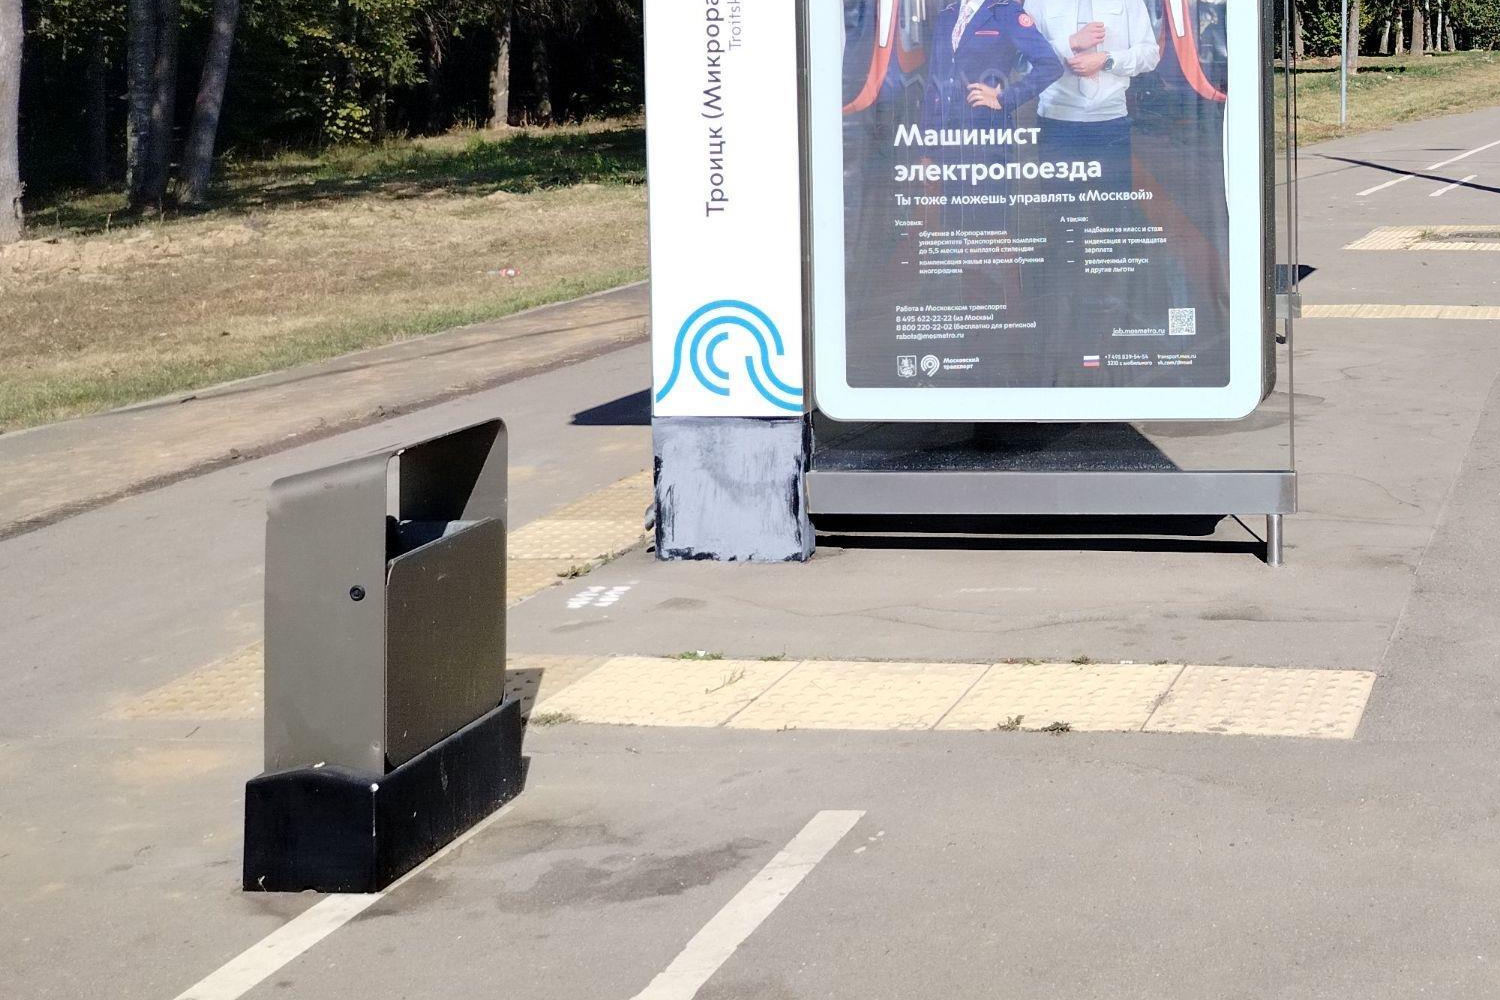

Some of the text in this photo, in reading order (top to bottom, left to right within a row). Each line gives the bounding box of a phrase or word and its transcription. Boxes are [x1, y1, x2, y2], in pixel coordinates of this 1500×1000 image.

[893, 124, 1041, 147] Машинист
[706, 126, 728, 218] Троицк
[894, 160, 1102, 185] электропоезда
[894, 189, 1153, 206] Ты тоже можешь управлять «Москвой»
[894, 219, 923, 227] Условия:
[1003, 321, 1037, 330] регионов)
[1112, 328, 1166, 336] job.mosmetro.ru
